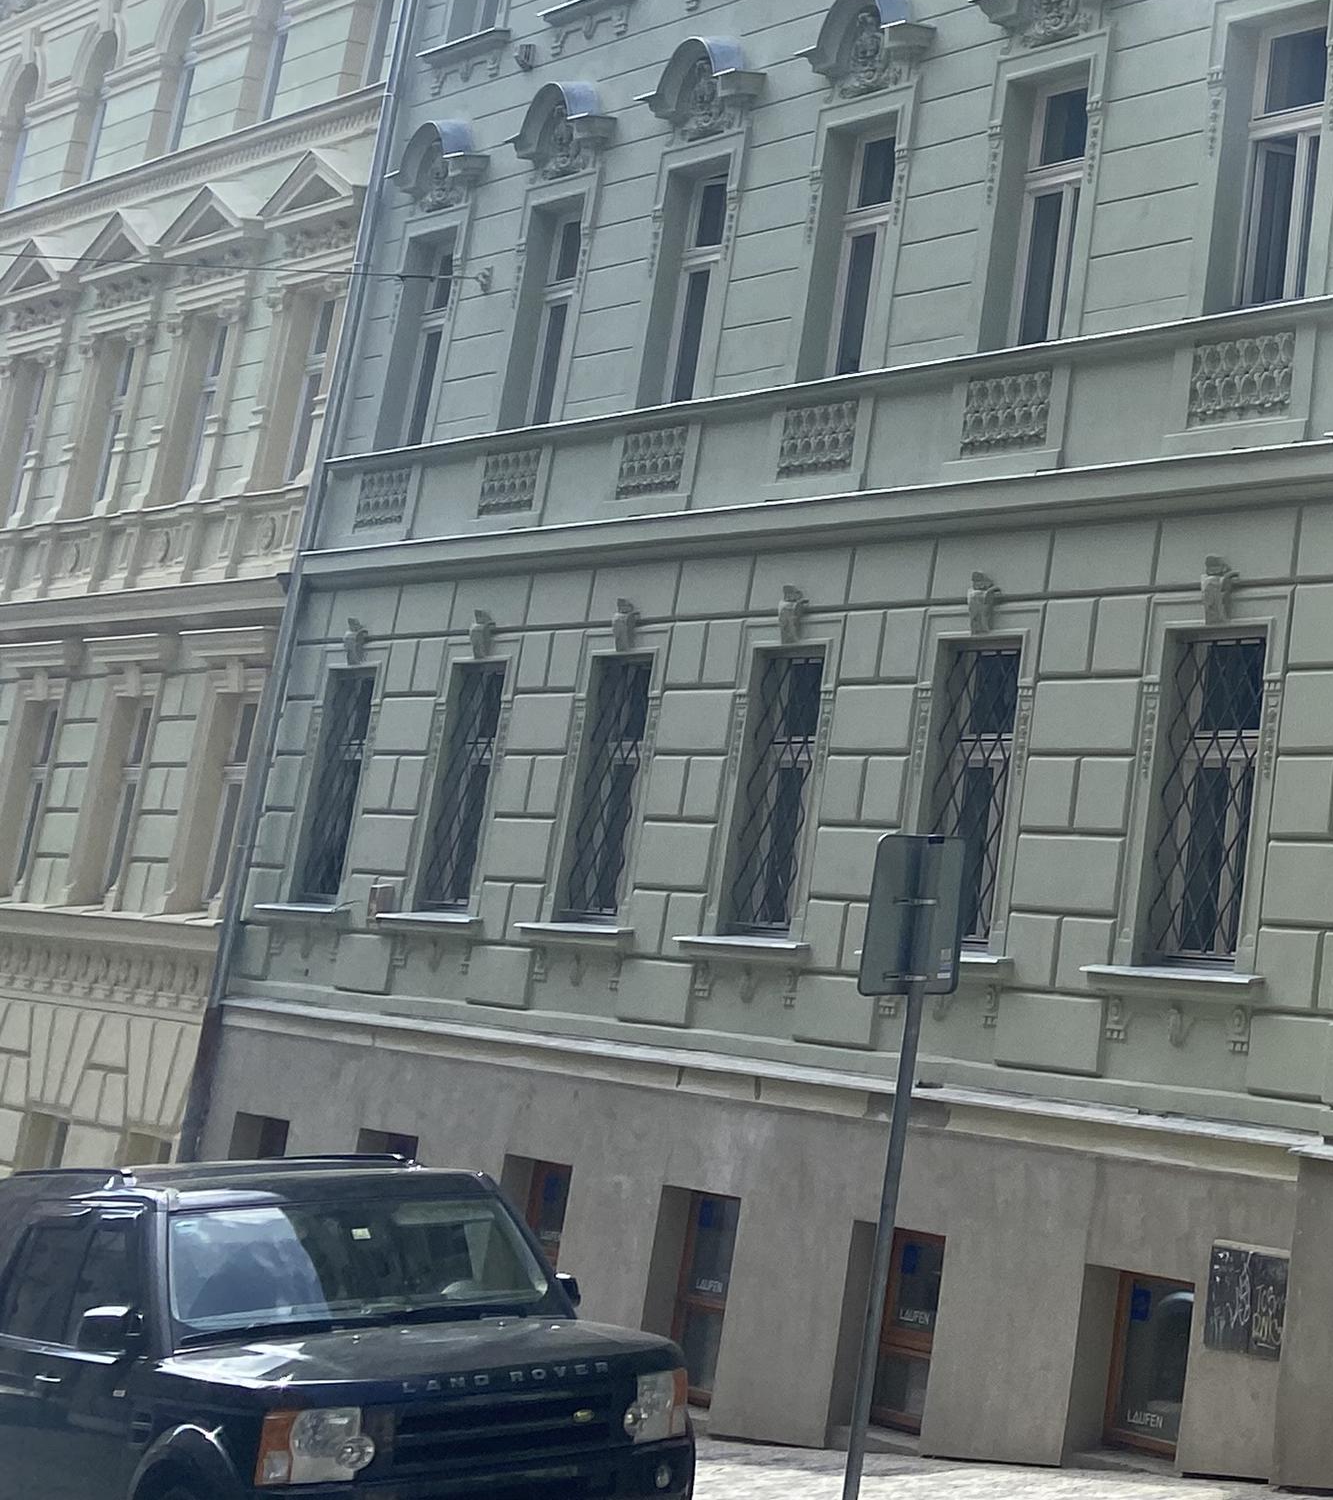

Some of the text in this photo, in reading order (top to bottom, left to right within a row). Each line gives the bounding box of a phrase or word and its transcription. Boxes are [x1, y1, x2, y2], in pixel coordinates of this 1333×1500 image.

[402, 1361, 609, 1393] LAND ROVER
[1127, 1409, 1164, 1429] LAUFEN
